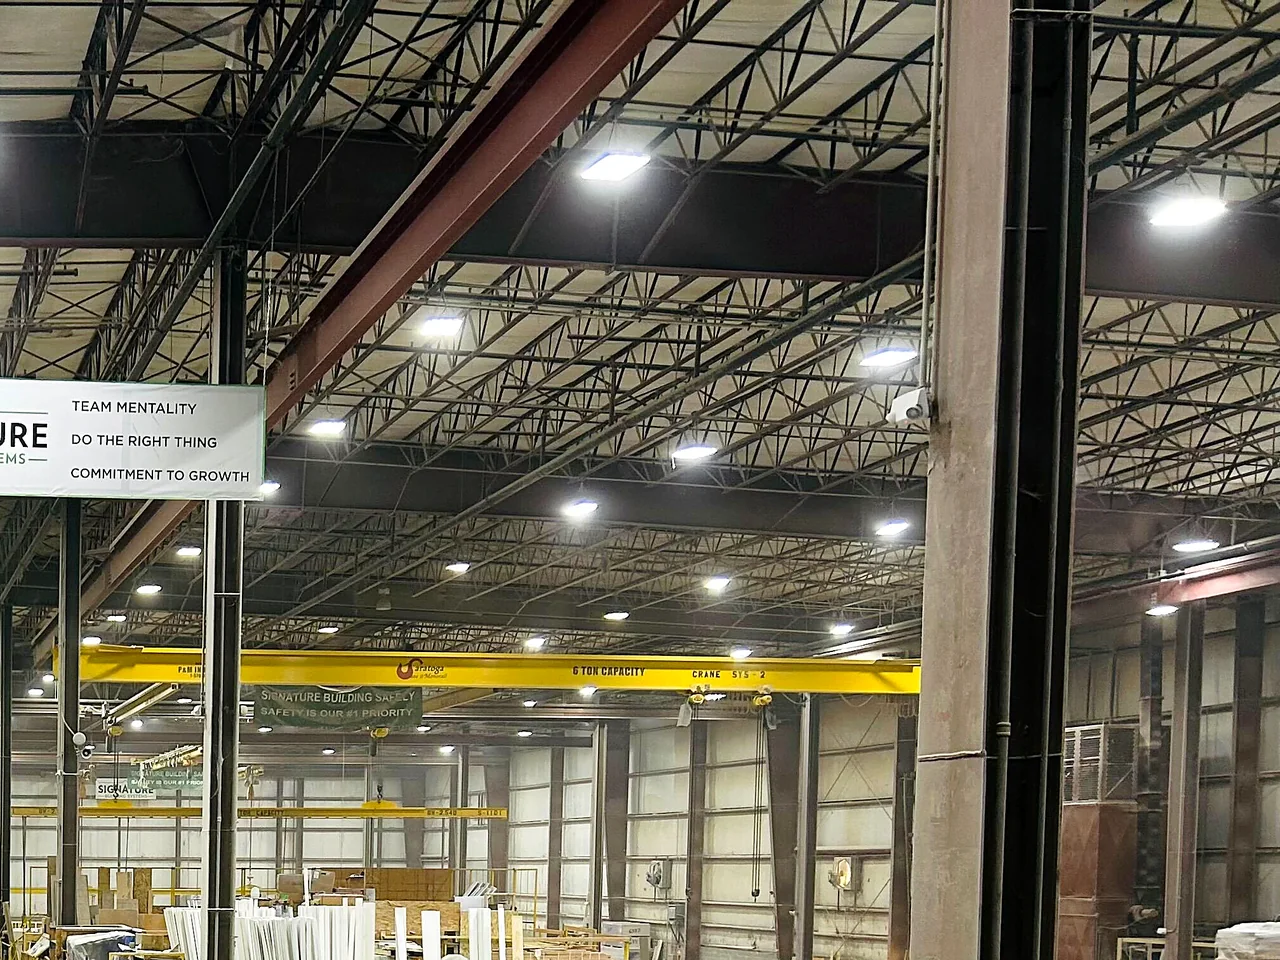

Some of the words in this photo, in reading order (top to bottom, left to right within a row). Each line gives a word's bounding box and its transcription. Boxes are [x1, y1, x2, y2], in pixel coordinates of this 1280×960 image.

[72, 400, 112, 413] TEAM
[116, 401, 197, 415] MENTALITY
[71, 434, 92, 445] DO
[97, 434, 124, 446] THE
[128, 435, 170, 447] RIGHT
[174, 436, 218, 449] THING
[70, 468, 163, 481] COMMITMENT
[167, 469, 185, 481] TO
[189, 470, 250, 482] GROWTH
[572, 666, 579, 675] 6
[581, 666, 600, 676] TON
[601, 667, 646, 677] CAPACITY
[692, 670, 721, 679] CRANE
[261, 691, 321, 702] SIGNATURE
[323, 692, 372, 703] BUILDING
[260, 707, 304, 717] SAFETY
[306, 709, 317, 717] IS
[320, 709, 344, 718] OUR
[346, 709, 358, 717] #1
[362, 708, 414, 718] PRIORITY
